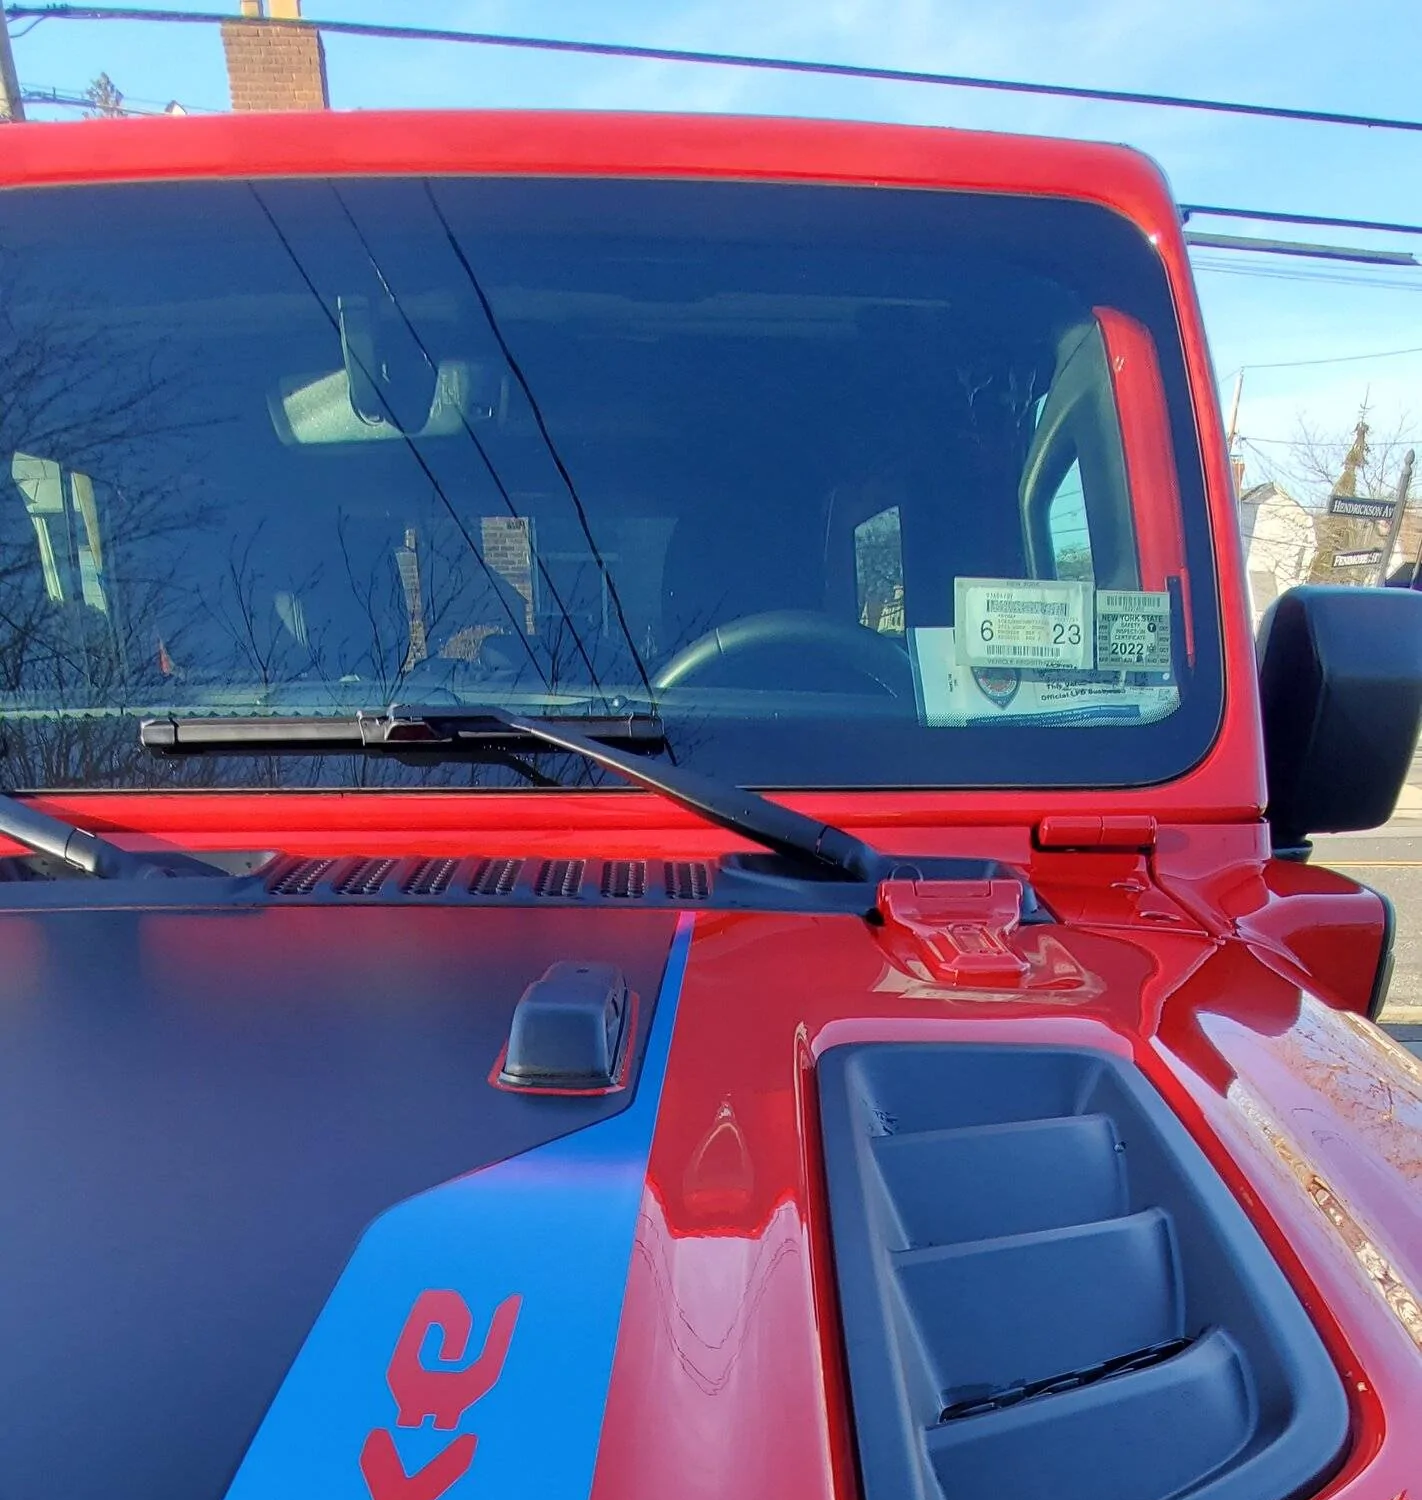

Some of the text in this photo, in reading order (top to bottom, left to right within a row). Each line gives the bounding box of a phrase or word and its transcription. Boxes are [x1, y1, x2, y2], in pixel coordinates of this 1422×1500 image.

[1333, 500, 1383, 516] HENDRICKSON
[1101, 614, 1164, 623] NEW YORK STATE
[980, 619, 994, 642] 6
[1052, 623, 1081, 645] 23
[1111, 642, 1144, 655] 2022
